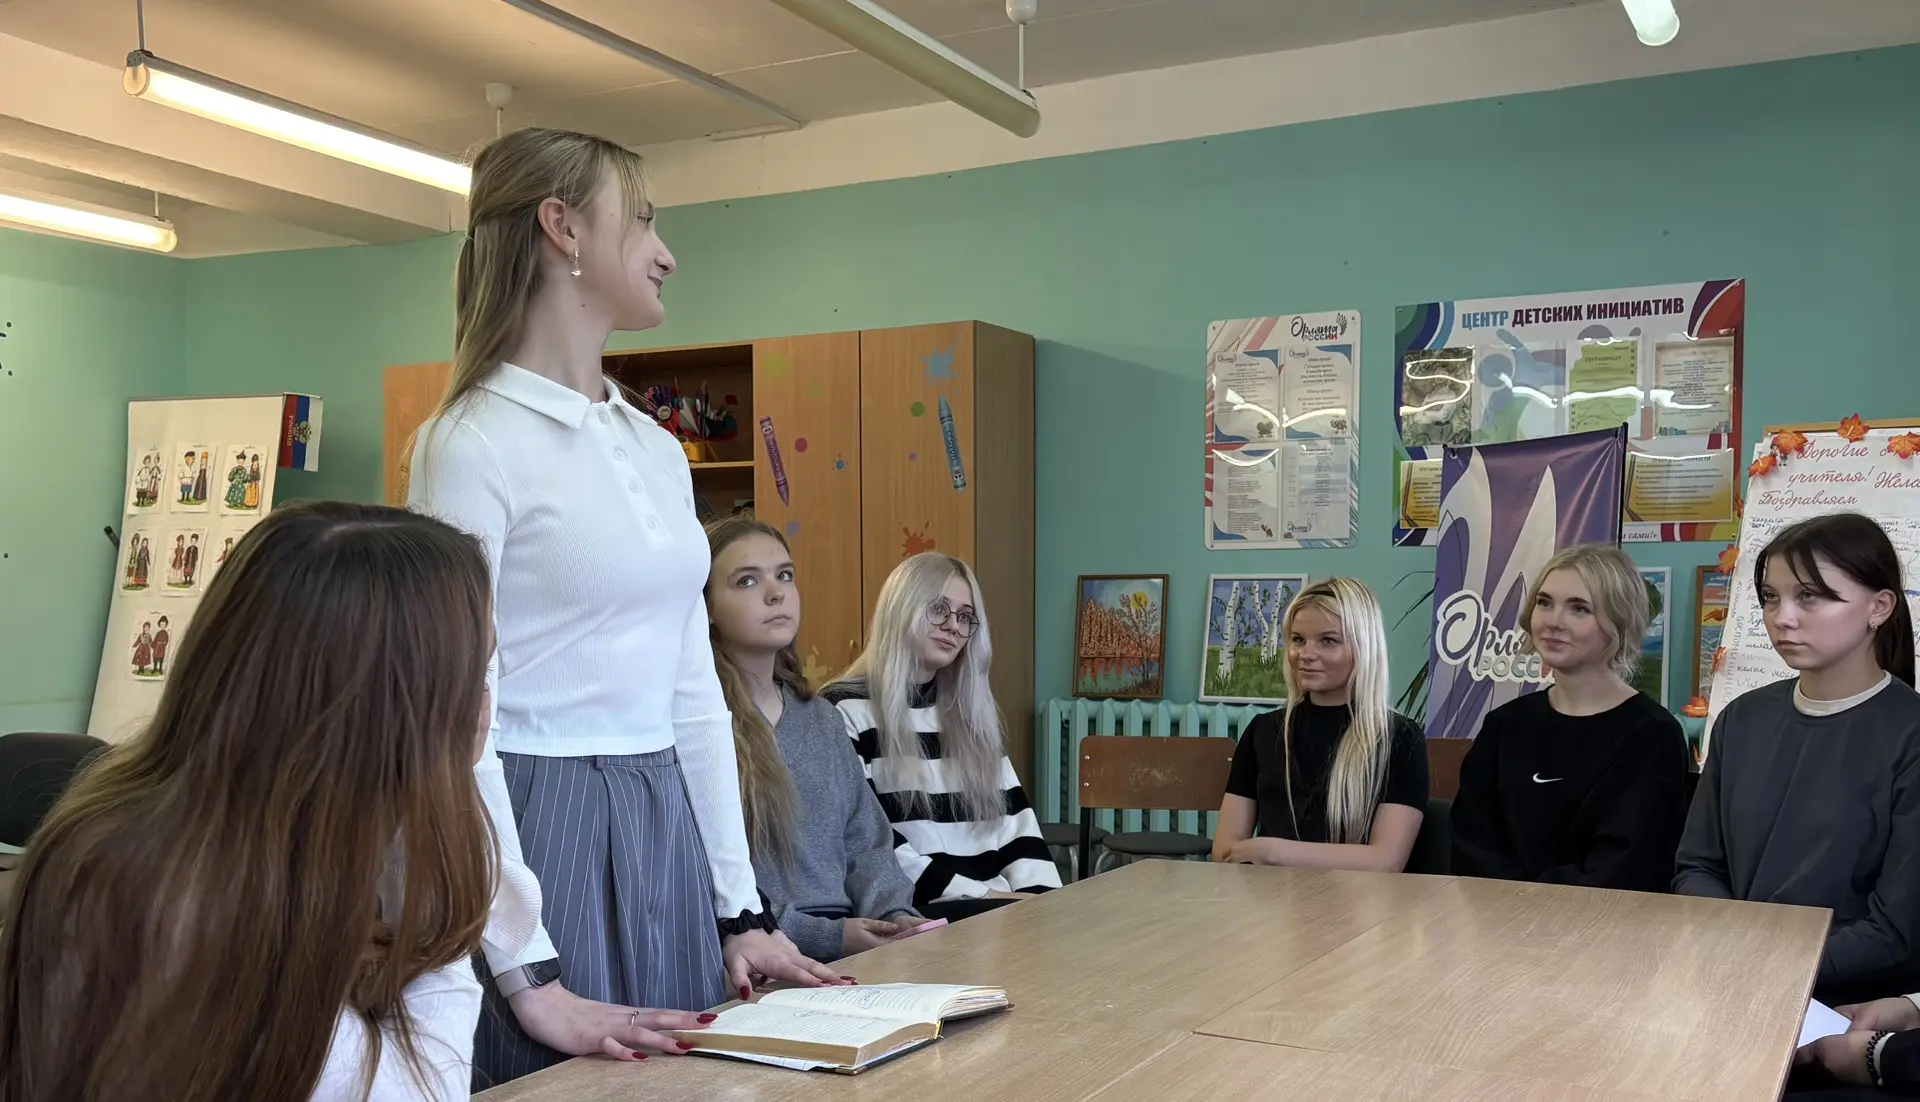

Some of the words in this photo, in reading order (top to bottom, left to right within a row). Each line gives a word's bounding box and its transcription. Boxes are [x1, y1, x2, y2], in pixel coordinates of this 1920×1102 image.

[1462, 310, 1509, 330] ЦЕНТР
[1511, 303, 1584, 327] ДЕТСКИХ
[1586, 298, 1685, 321] ИНИЦИАТИВ
[1291, 316, 1338, 339] Орлята
[1303, 333, 1338, 341] РОССИИ
[1796, 439, 1869, 463] Дорогие
[1787, 465, 1875, 488] учителя!
[1758, 490, 1858, 511] Поздравляем
[1476, 656, 1552, 678] РОСС
